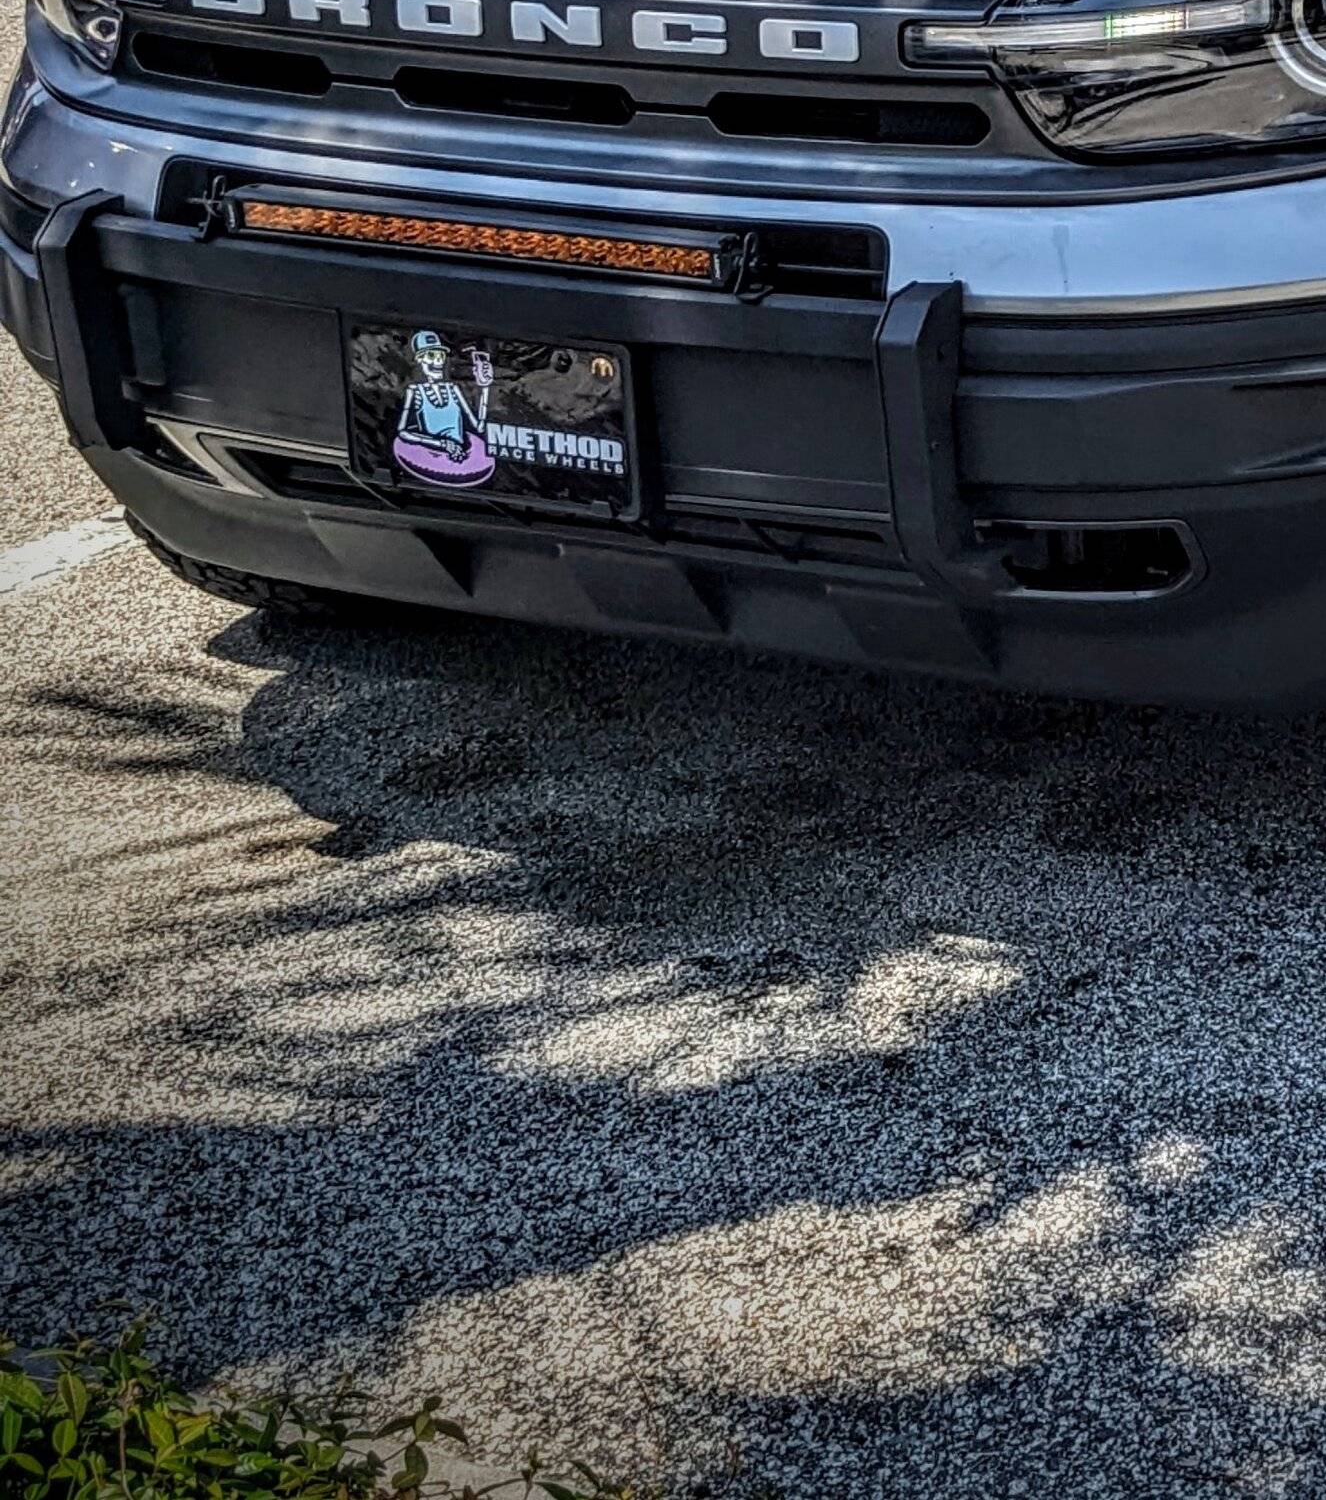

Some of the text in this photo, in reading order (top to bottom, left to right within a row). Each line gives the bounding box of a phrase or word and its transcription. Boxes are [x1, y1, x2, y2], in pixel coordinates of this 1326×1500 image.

[486, 422, 624, 462] METHOD
[488, 445, 625, 475] RACE WHEELS
